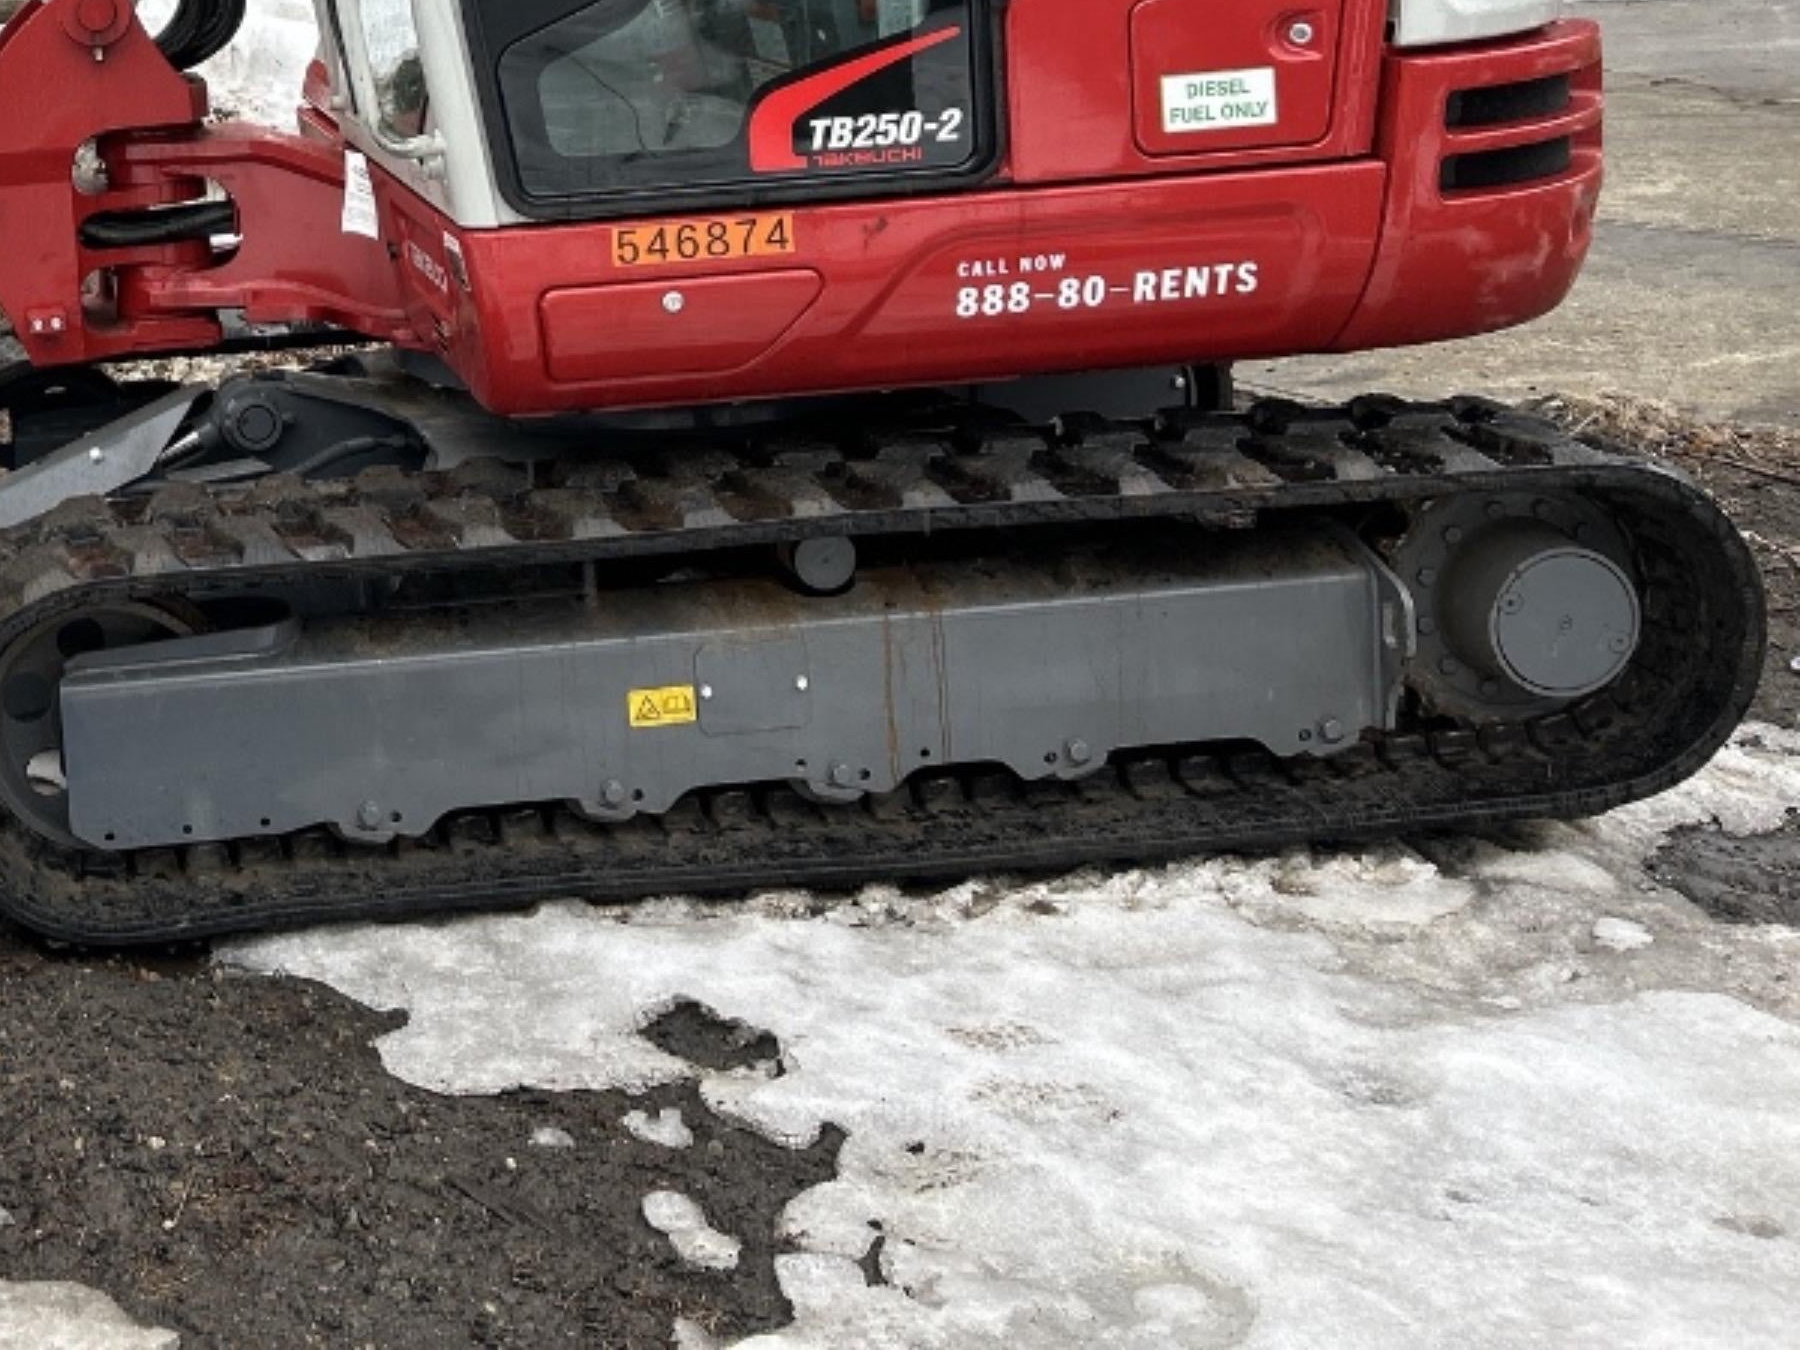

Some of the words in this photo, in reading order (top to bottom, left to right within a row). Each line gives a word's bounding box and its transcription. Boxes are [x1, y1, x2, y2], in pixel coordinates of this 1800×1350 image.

[1185, 78, 1251, 99] DIESEL
[1169, 104, 1216, 124] FUEL
[1220, 98, 1269, 120] ONLY
[808, 107, 963, 150] TB250-2
[617, 217, 790, 264] 546874
[957, 258, 1009, 277] CALL
[1019, 253, 1066, 273] NOW
[955, 261, 1258, 317] 888-80-RENTS
